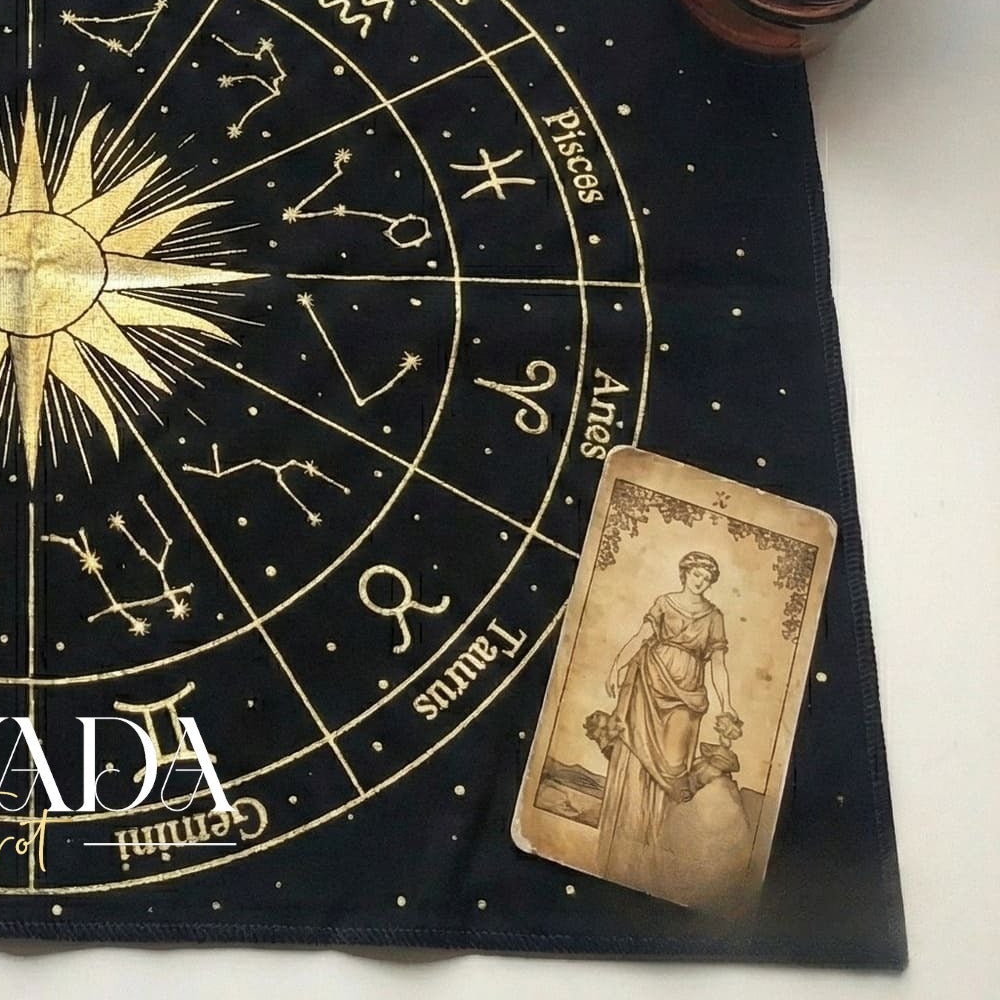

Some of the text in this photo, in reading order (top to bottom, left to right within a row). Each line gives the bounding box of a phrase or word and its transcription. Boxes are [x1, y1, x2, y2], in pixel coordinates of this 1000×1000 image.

[541, 106, 604, 205] Pisces
[412, 618, 527, 720] Taurus
[114, 797, 268, 871] Gemini
